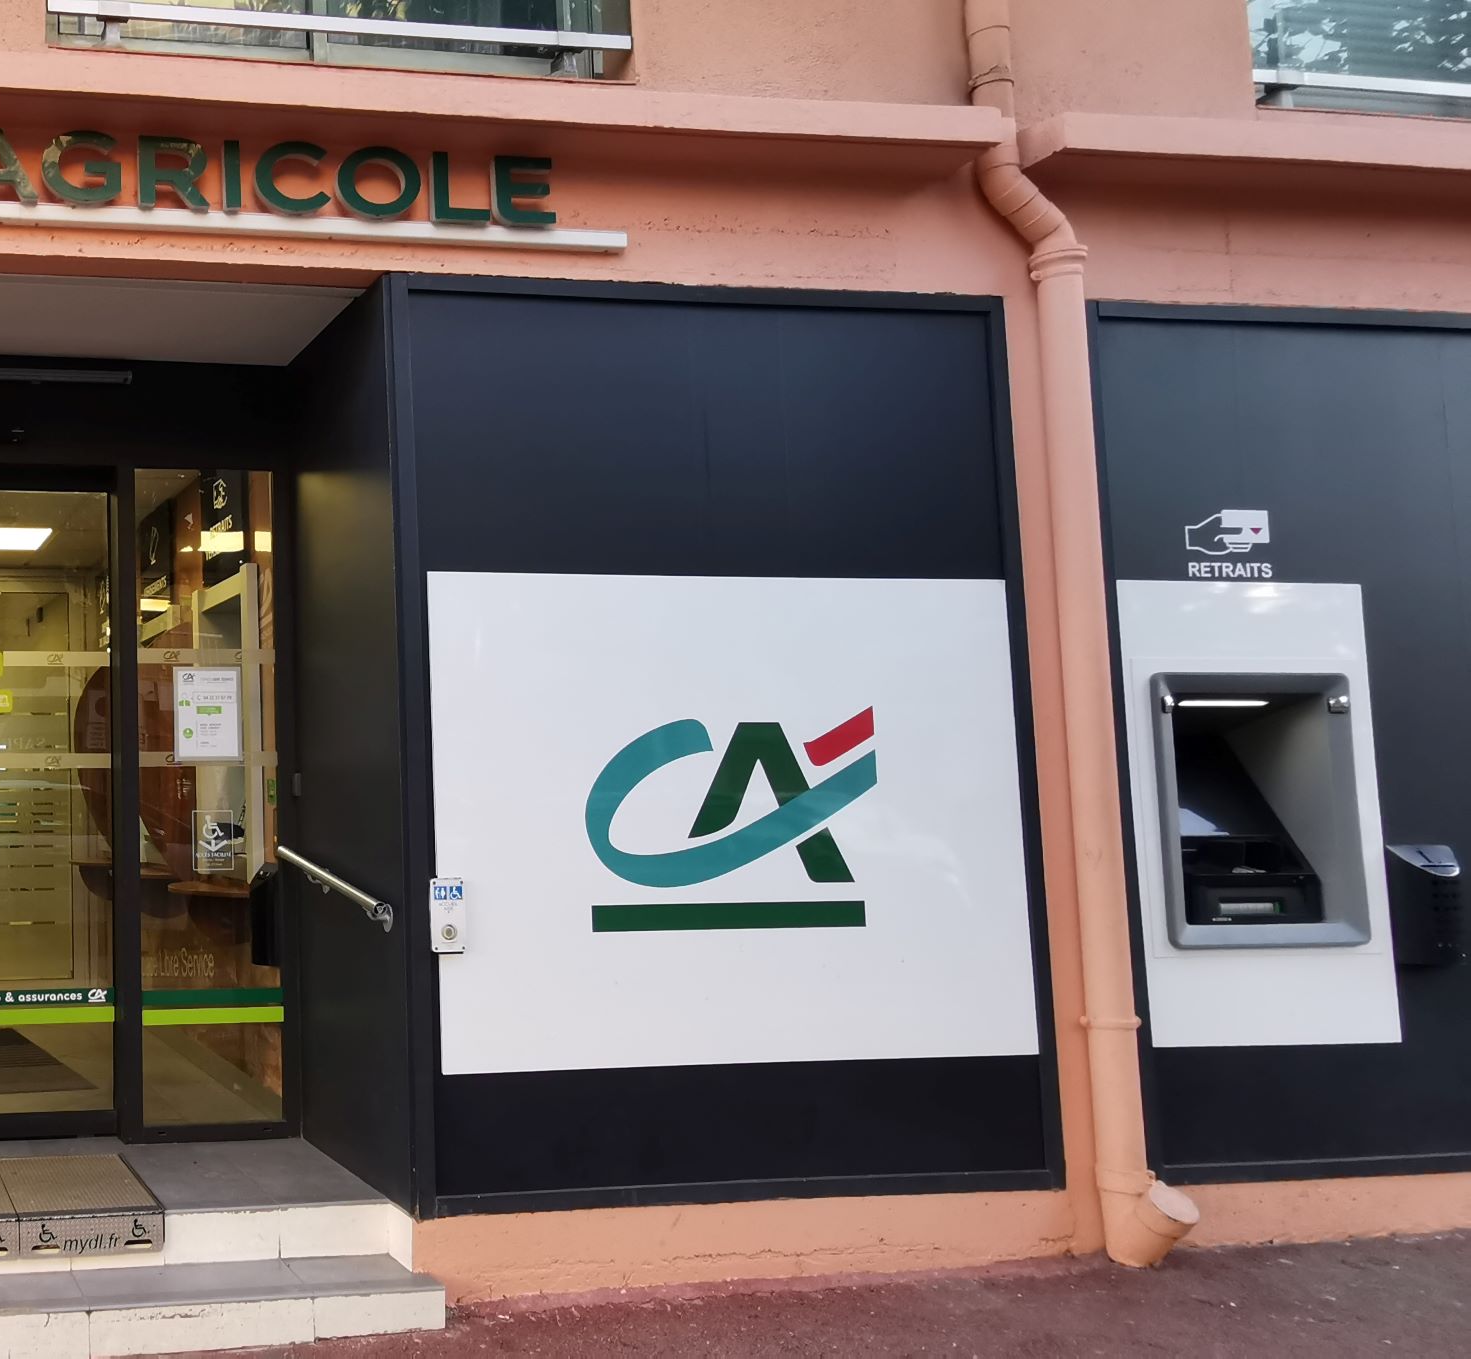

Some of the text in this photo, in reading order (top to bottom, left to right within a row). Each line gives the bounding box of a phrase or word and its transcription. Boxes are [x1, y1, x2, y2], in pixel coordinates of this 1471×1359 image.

[1188, 562, 1273, 578] RETRAITS
[5, 992, 14, 1003] &
[18, 992, 83, 1003] assurances
[63, 1232, 121, 1255] mydl.fr
